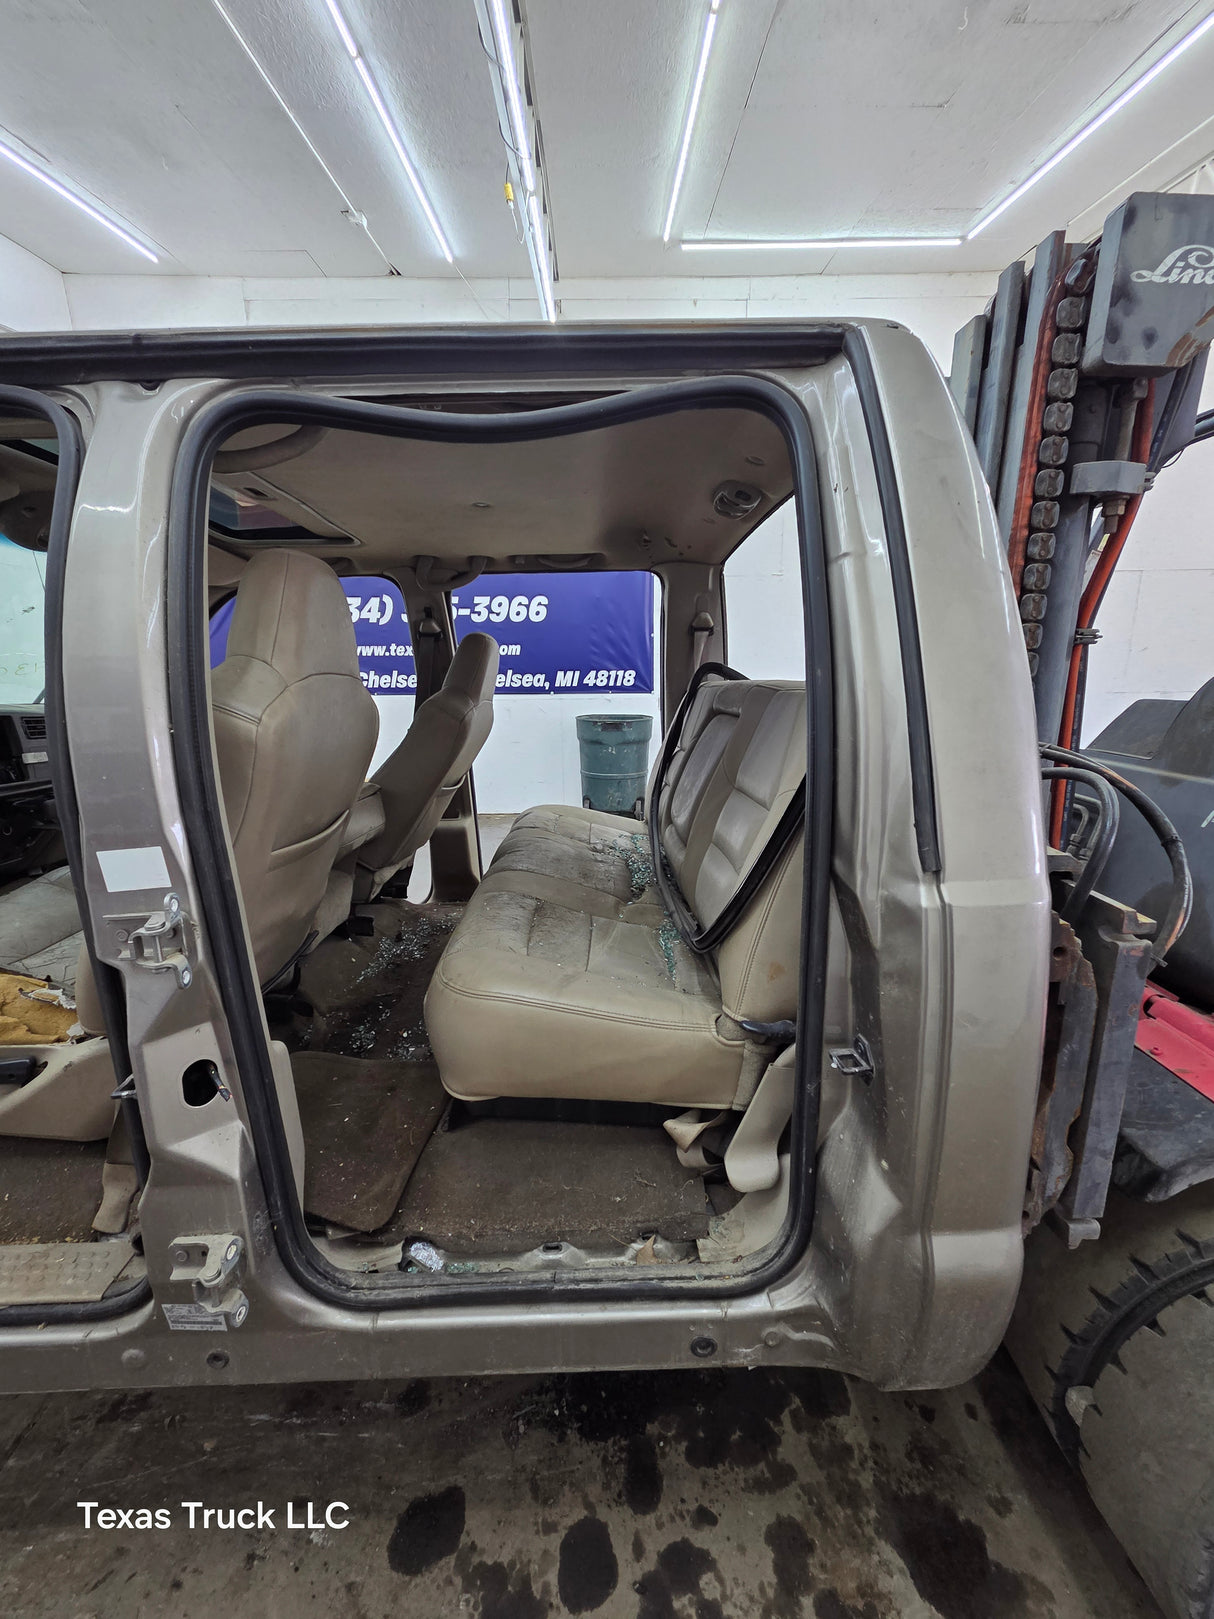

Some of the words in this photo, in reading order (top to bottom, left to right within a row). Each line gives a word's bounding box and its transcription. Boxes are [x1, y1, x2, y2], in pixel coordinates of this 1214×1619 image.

[346, 594, 394, 626] 34)
[359, 670, 418, 689] Chelse
[495, 669, 550, 690] elsea,
[554, 670, 581, 687] MI
[583, 669, 637, 688] 48118
